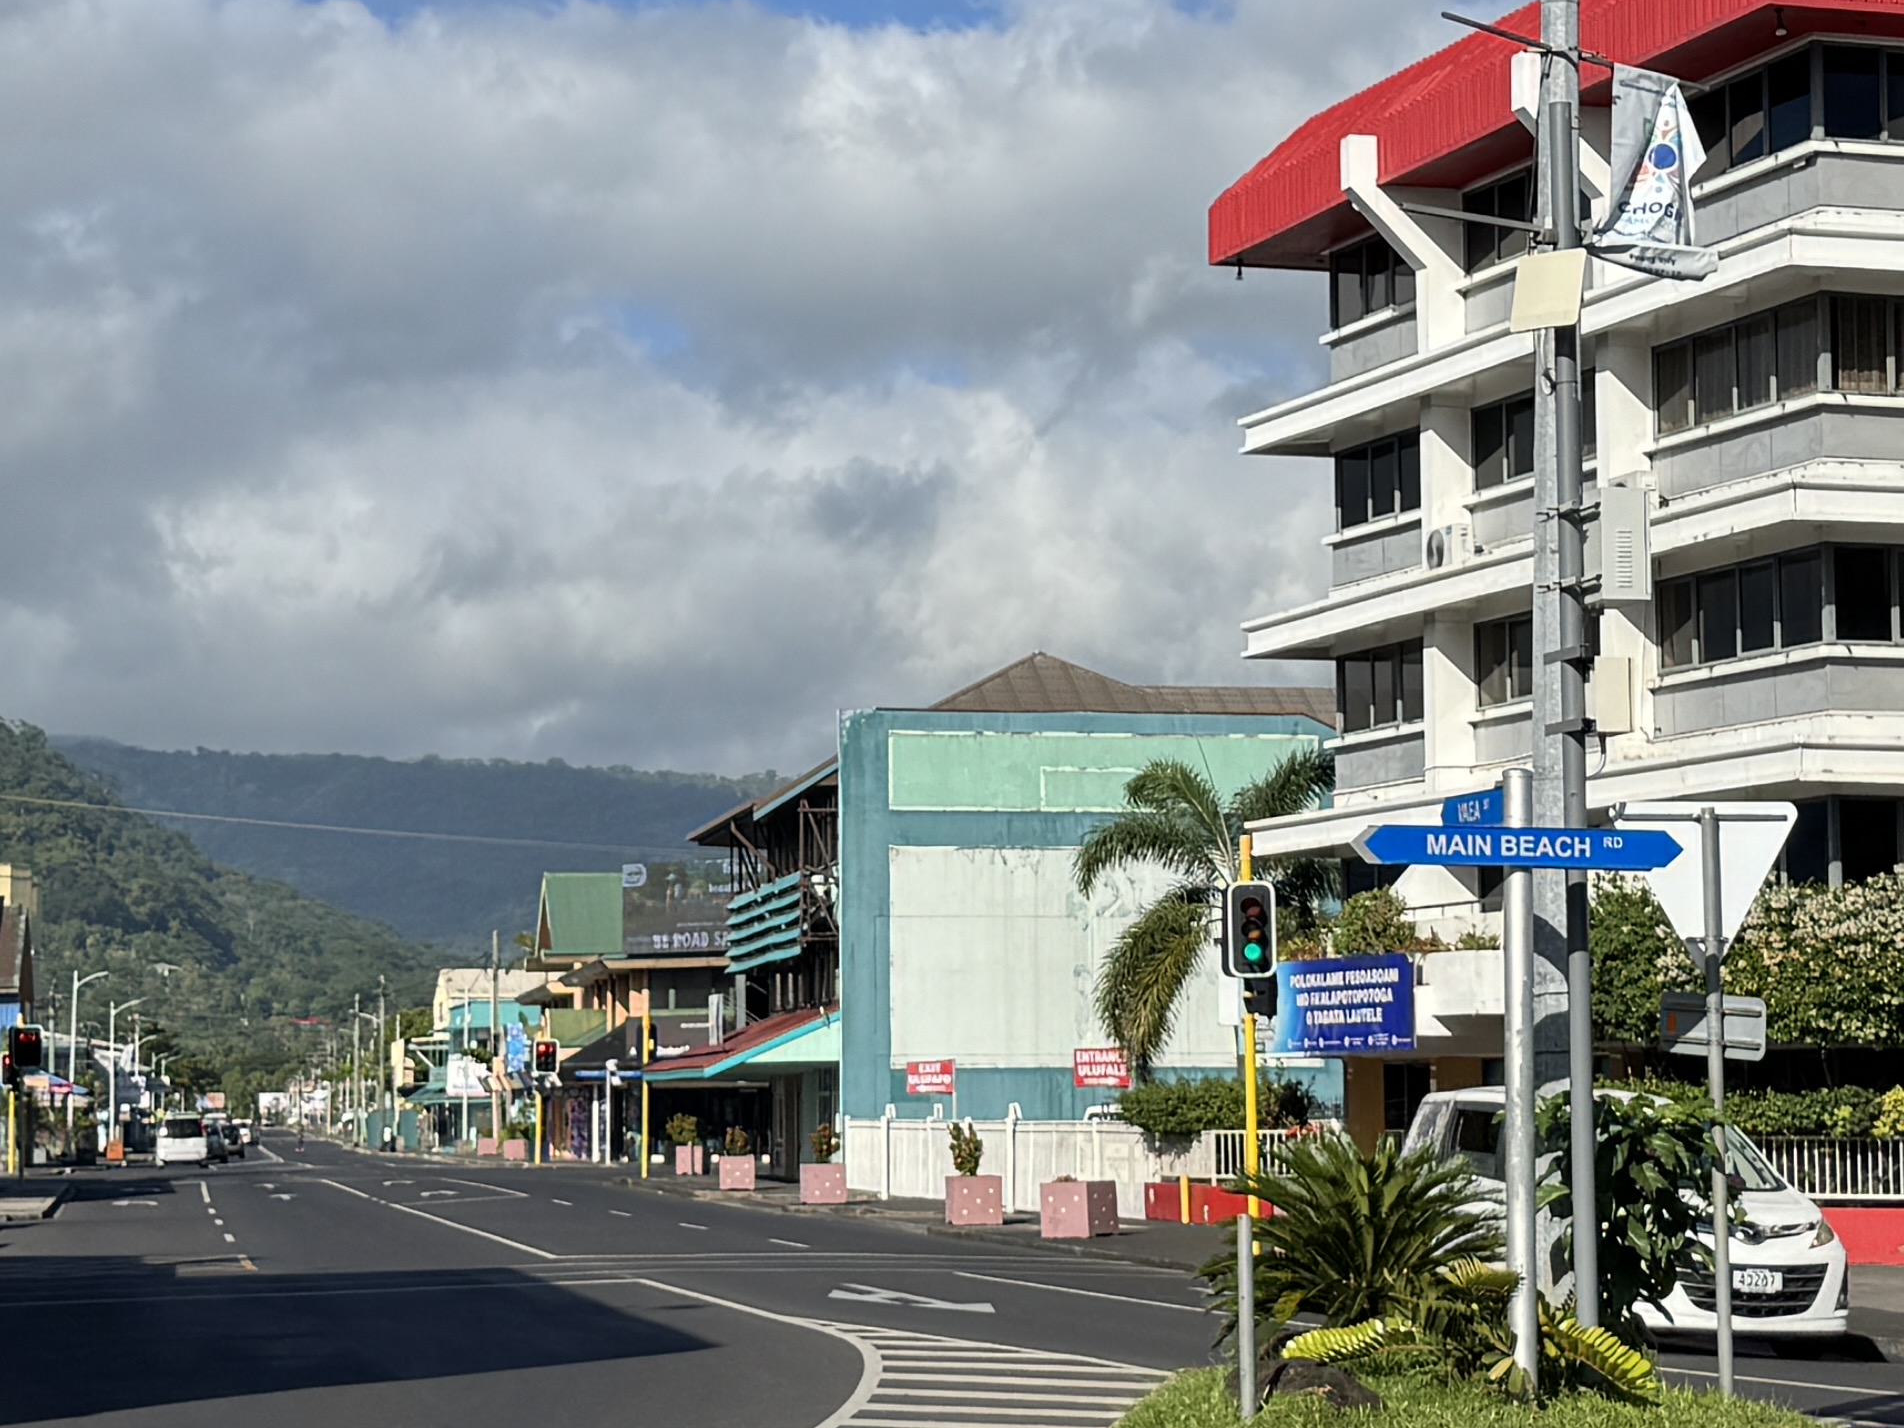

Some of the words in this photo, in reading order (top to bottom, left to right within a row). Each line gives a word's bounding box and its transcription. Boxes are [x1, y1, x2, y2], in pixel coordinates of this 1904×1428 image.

[1427, 834, 1492, 857] MAIN
[1500, 835, 1591, 859] BEACH
[1603, 836, 1623, 849] RD
[918, 1063, 941, 1074] EXIT
[1078, 1064, 1127, 1077] ULUFALE
